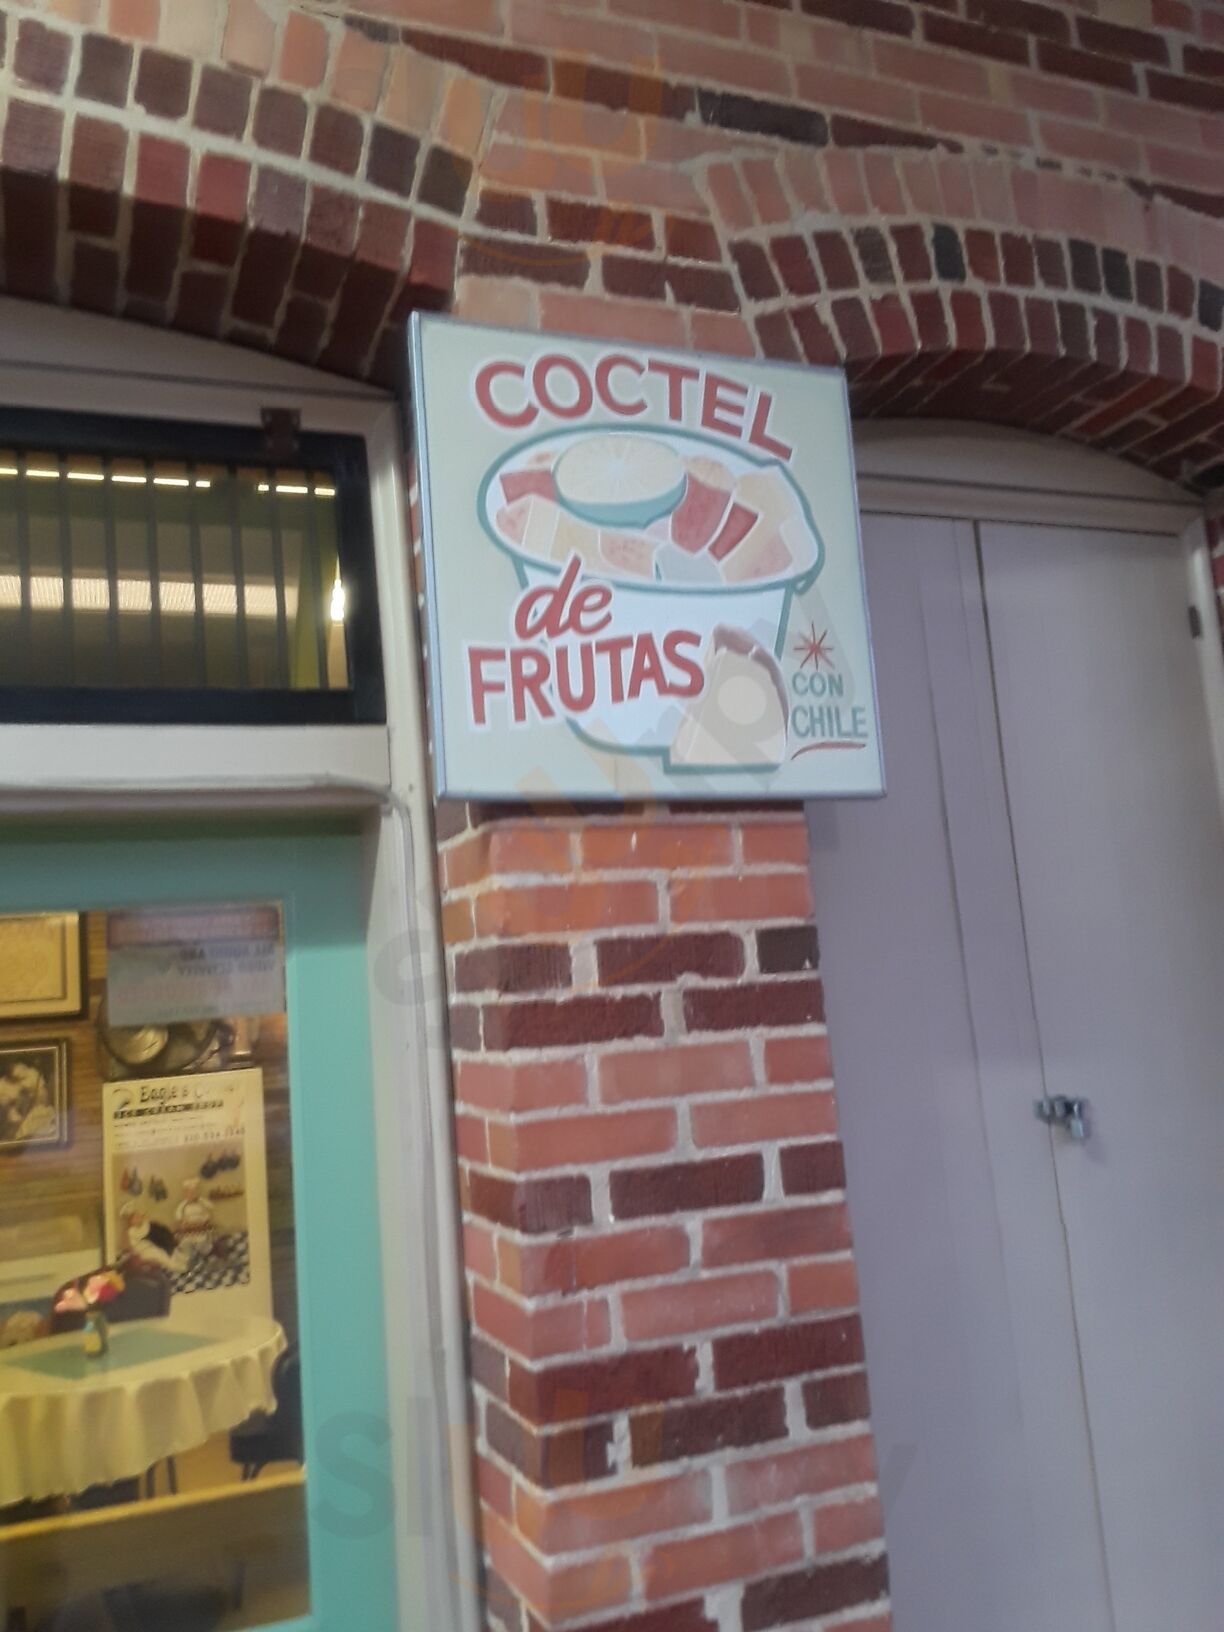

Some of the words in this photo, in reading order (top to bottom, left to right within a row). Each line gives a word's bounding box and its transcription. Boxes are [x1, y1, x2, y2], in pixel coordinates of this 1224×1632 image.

[476, 354, 791, 462] COCTEL
[514, 555, 613, 640] de
[467, 630, 705, 724] FRUTAS
[792, 671, 844, 698] CON
[791, 706, 868, 739] CHILE
